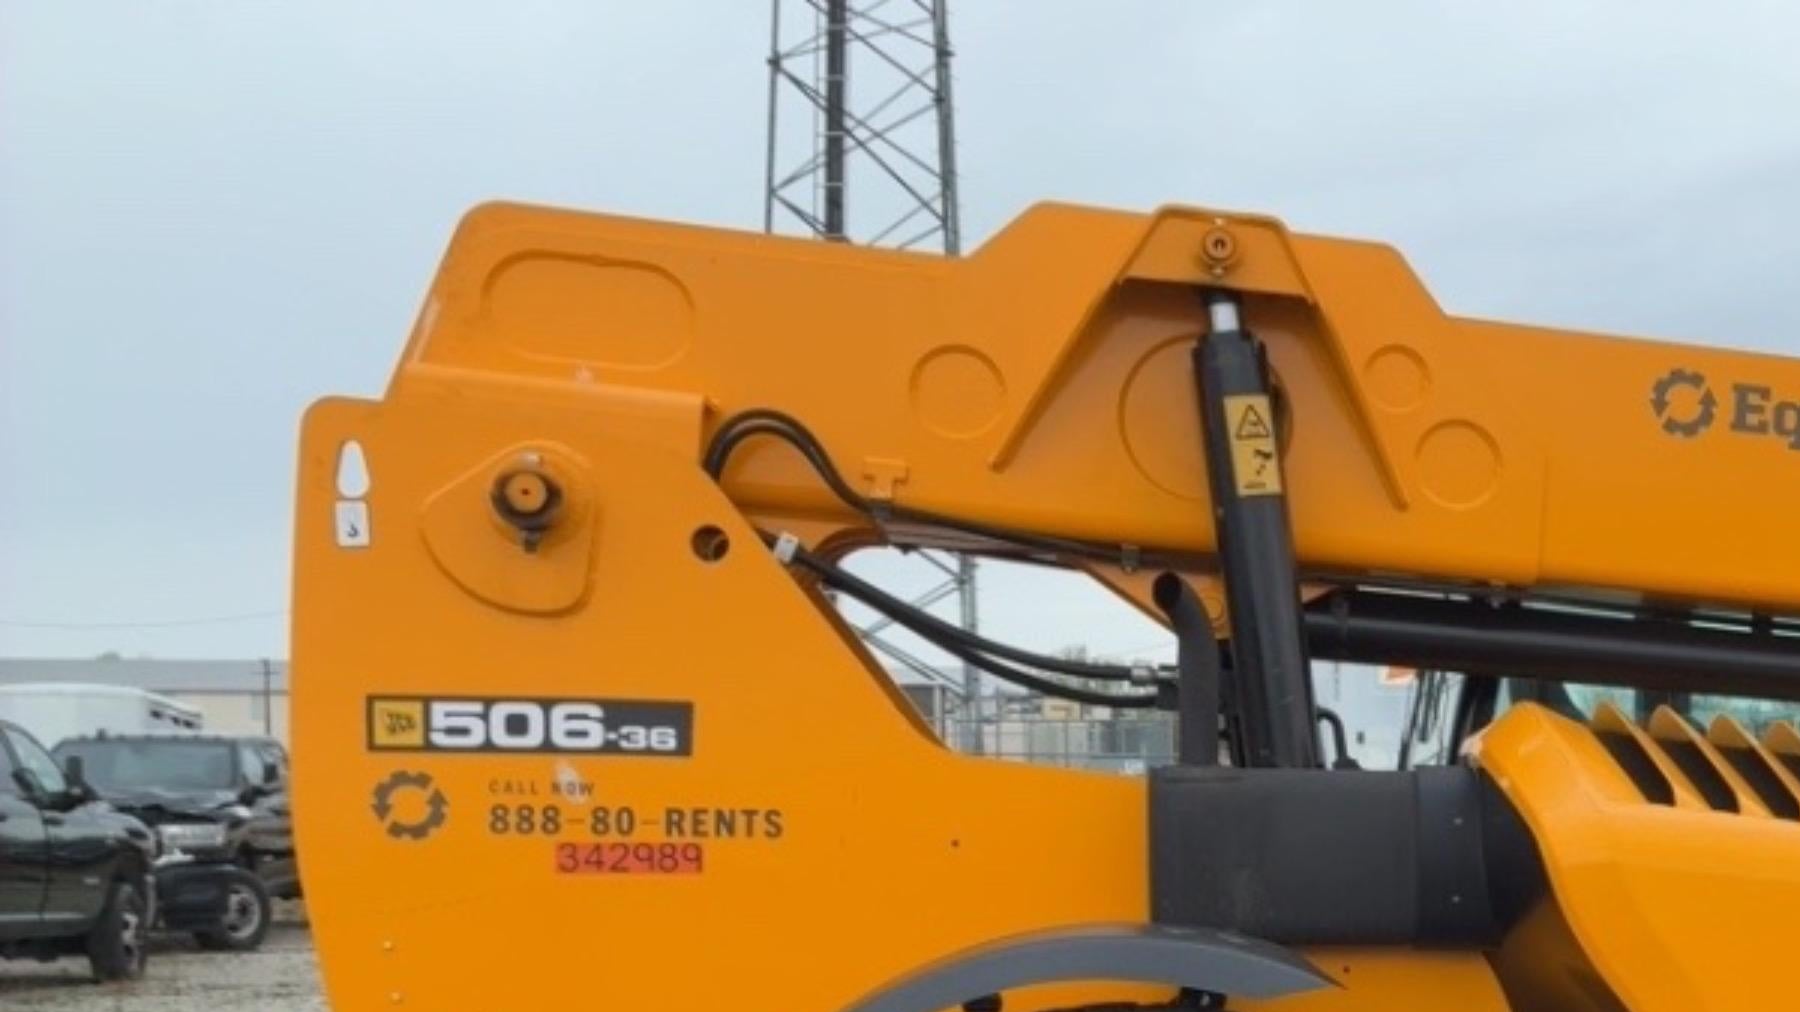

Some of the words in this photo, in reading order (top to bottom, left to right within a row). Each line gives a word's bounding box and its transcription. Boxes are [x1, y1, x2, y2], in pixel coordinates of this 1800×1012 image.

[429, 700, 677, 750] 506-36
[488, 779, 538, 795] CALL
[489, 804, 783, 839] 888-80-RENTS
[557, 842, 702, 873] 342989
